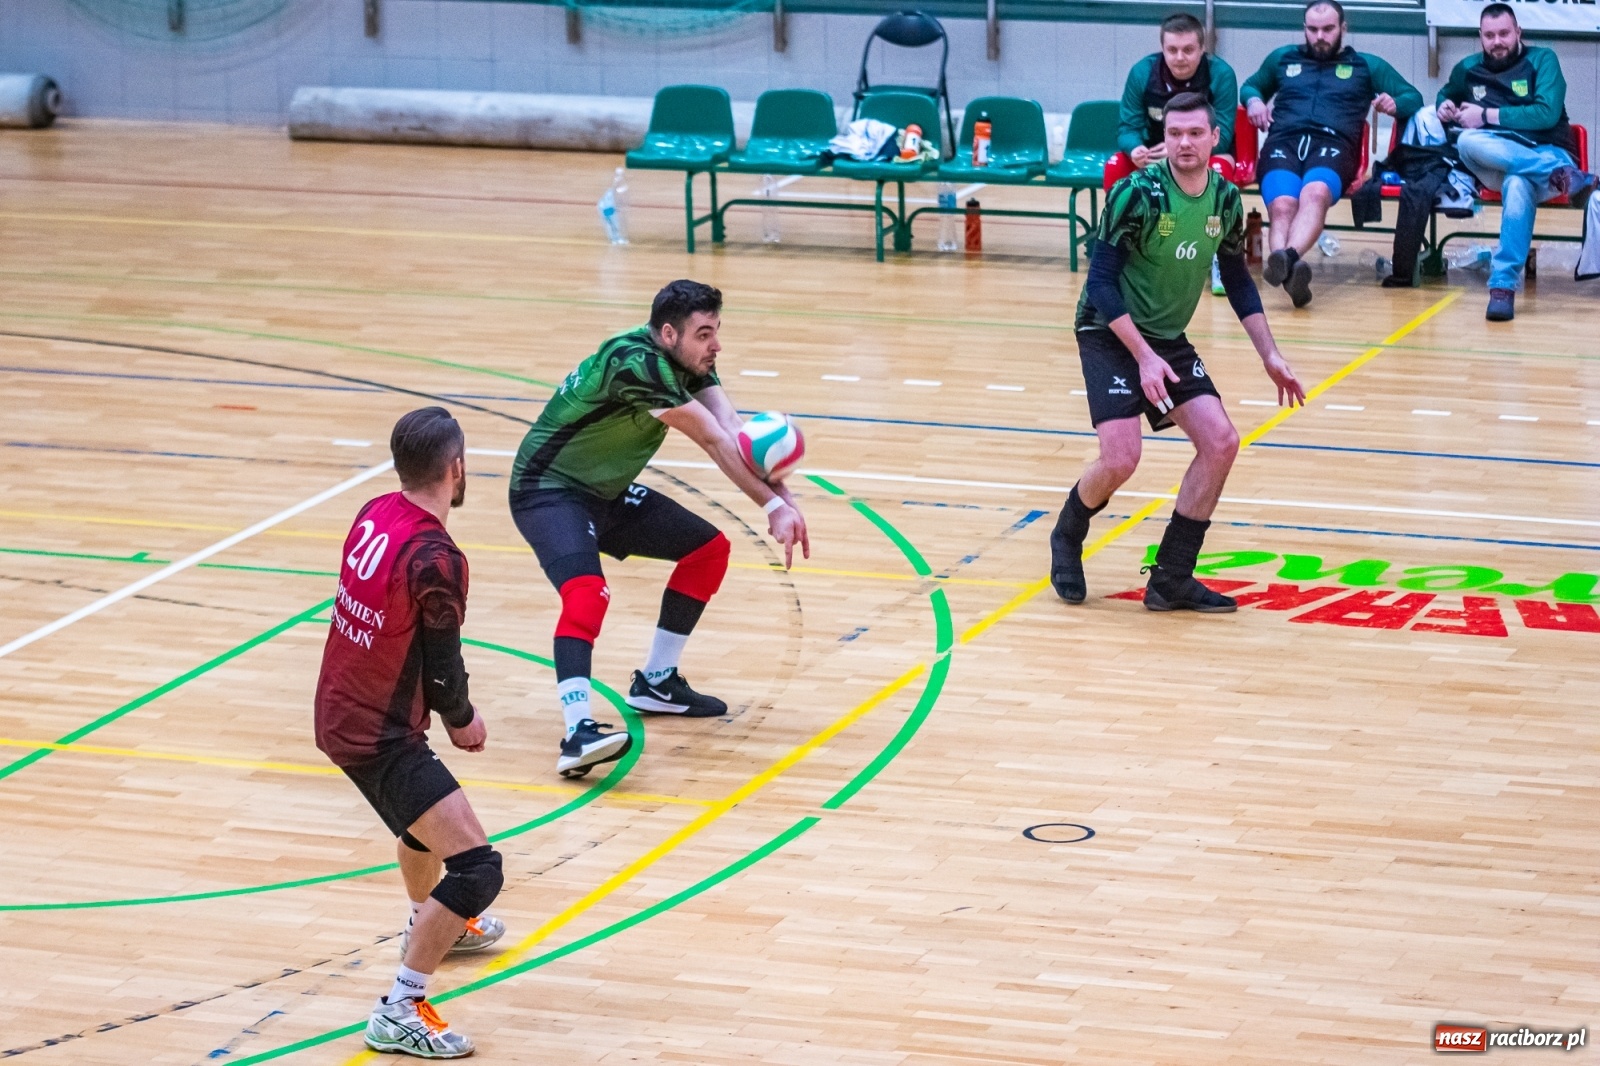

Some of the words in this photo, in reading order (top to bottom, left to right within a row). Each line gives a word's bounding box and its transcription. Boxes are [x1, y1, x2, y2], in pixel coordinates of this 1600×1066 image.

[1175, 240, 1199, 260] 66
[624, 484, 648, 507] 15
[346, 519, 390, 581] 20
